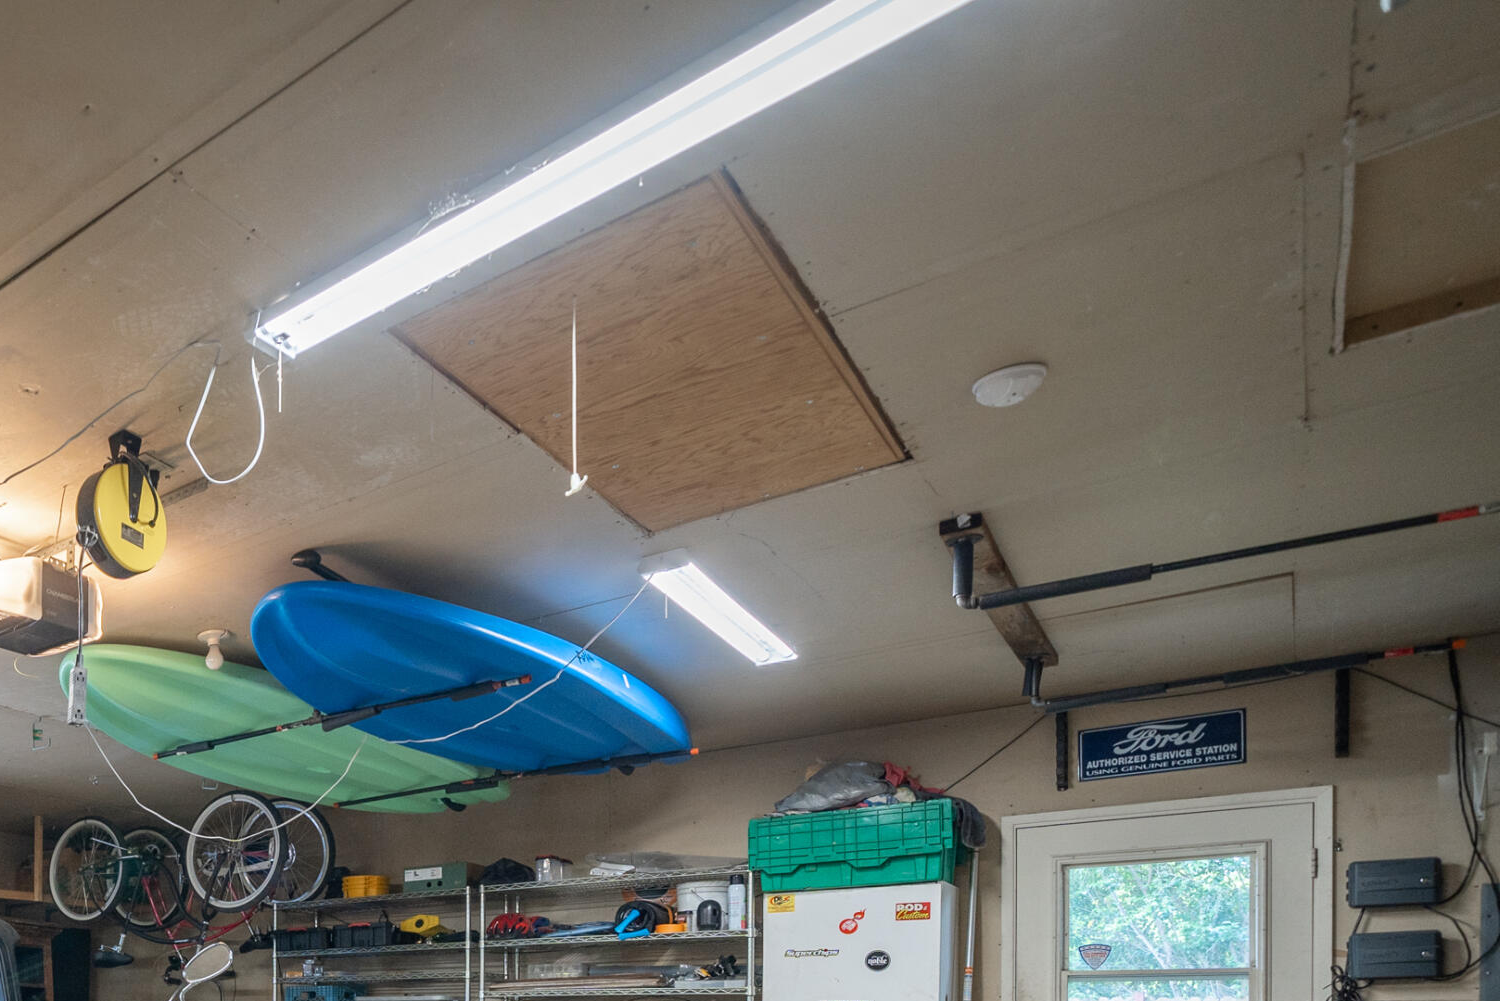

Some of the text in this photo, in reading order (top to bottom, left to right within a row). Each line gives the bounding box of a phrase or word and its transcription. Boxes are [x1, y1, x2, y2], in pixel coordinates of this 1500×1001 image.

[1113, 722, 1207, 755] Ford
[1086, 743, 1238, 769] AUTHORIZED SERVICE STATION
[1086, 753, 1238, 777] USING GENUINE FORD PARTS
[897, 903, 924, 911] ROD
[897, 908, 930, 920] Custom
[785, 948, 839, 958] Superchips
